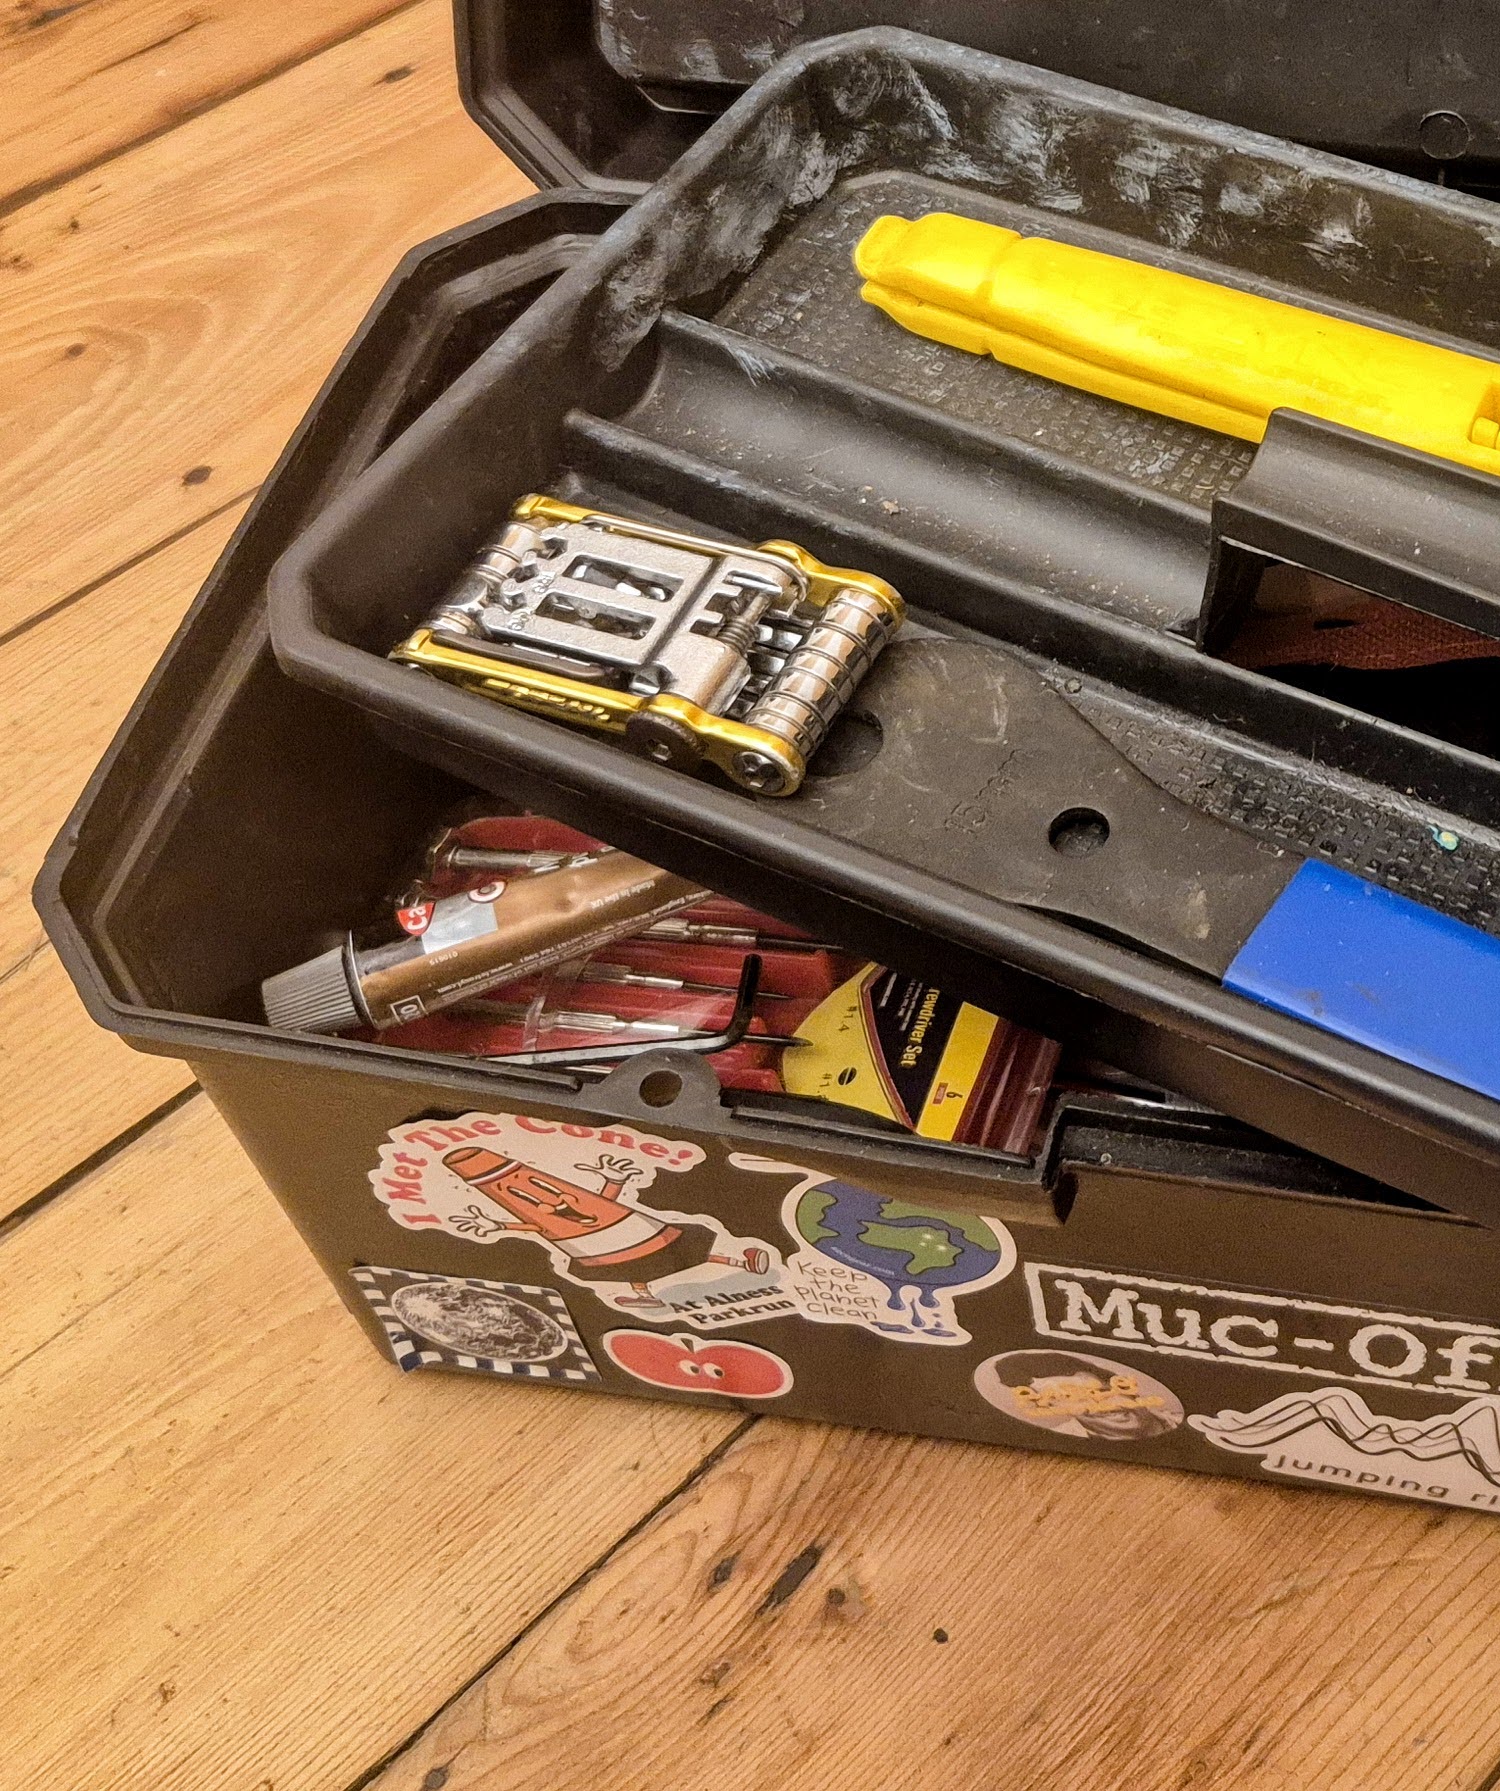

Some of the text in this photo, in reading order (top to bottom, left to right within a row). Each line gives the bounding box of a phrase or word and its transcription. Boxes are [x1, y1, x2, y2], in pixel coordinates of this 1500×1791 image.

[381, 1114, 693, 1226] I Met The Cone!
[669, 1284, 785, 1314] At Alness
[809, 1277, 861, 1295] the
[689, 1298, 796, 1324] Parkrun
[1272, 1451, 1450, 1501] jumping
